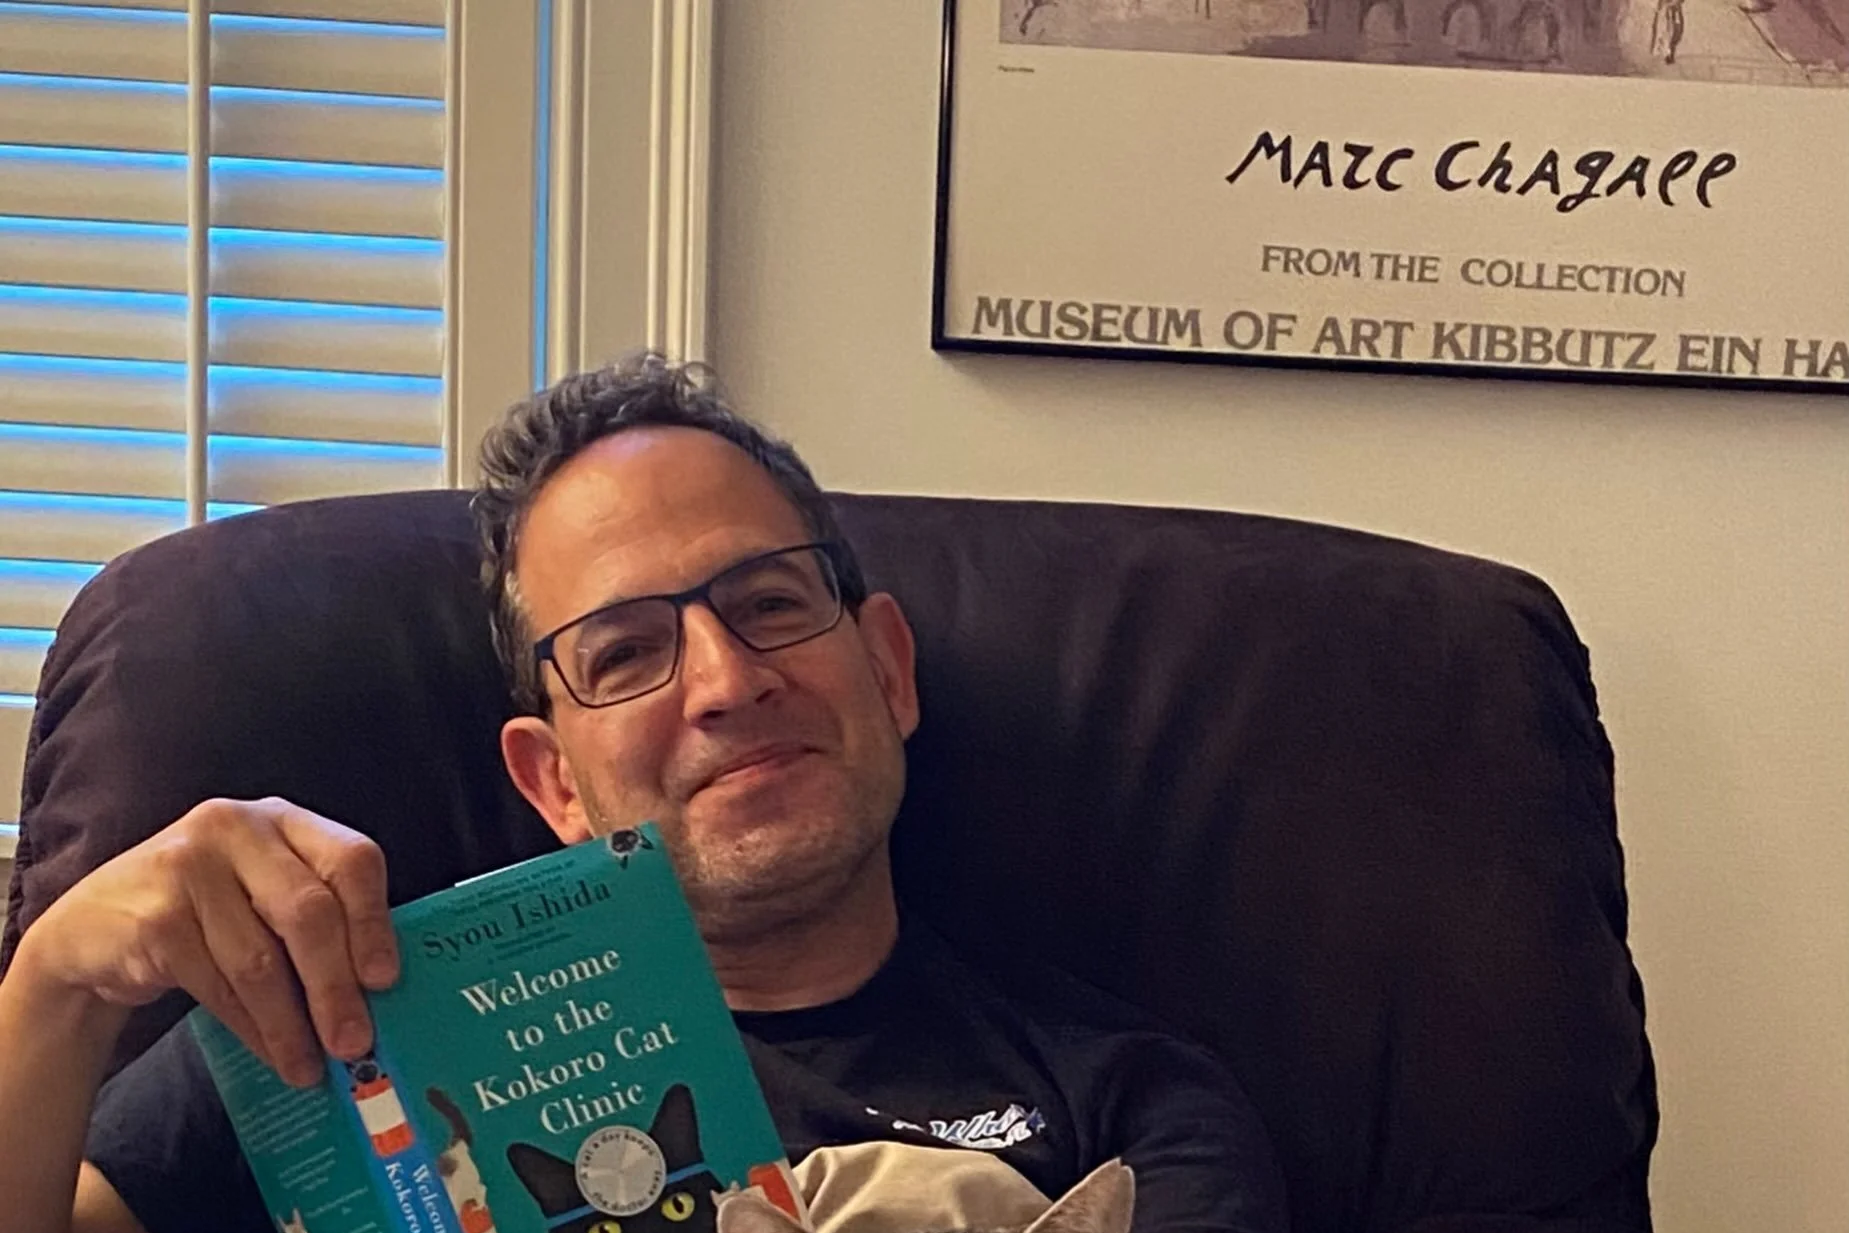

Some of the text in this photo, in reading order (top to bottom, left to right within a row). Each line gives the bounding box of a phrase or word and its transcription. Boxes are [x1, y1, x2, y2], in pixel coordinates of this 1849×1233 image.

[1261, 244, 1687, 298] FROM THE COLLECTION
[971, 295, 1849, 379] MUSEUM OF ART KIBBUTZ EIN HA
[421, 917, 505, 962] Syou
[510, 879, 612, 929] Ishida
[460, 949, 622, 1016] Welcome
[506, 999, 615, 1053] to the
[472, 1021, 680, 1112] Kokoro Cat
[540, 1080, 646, 1135] Clinic
